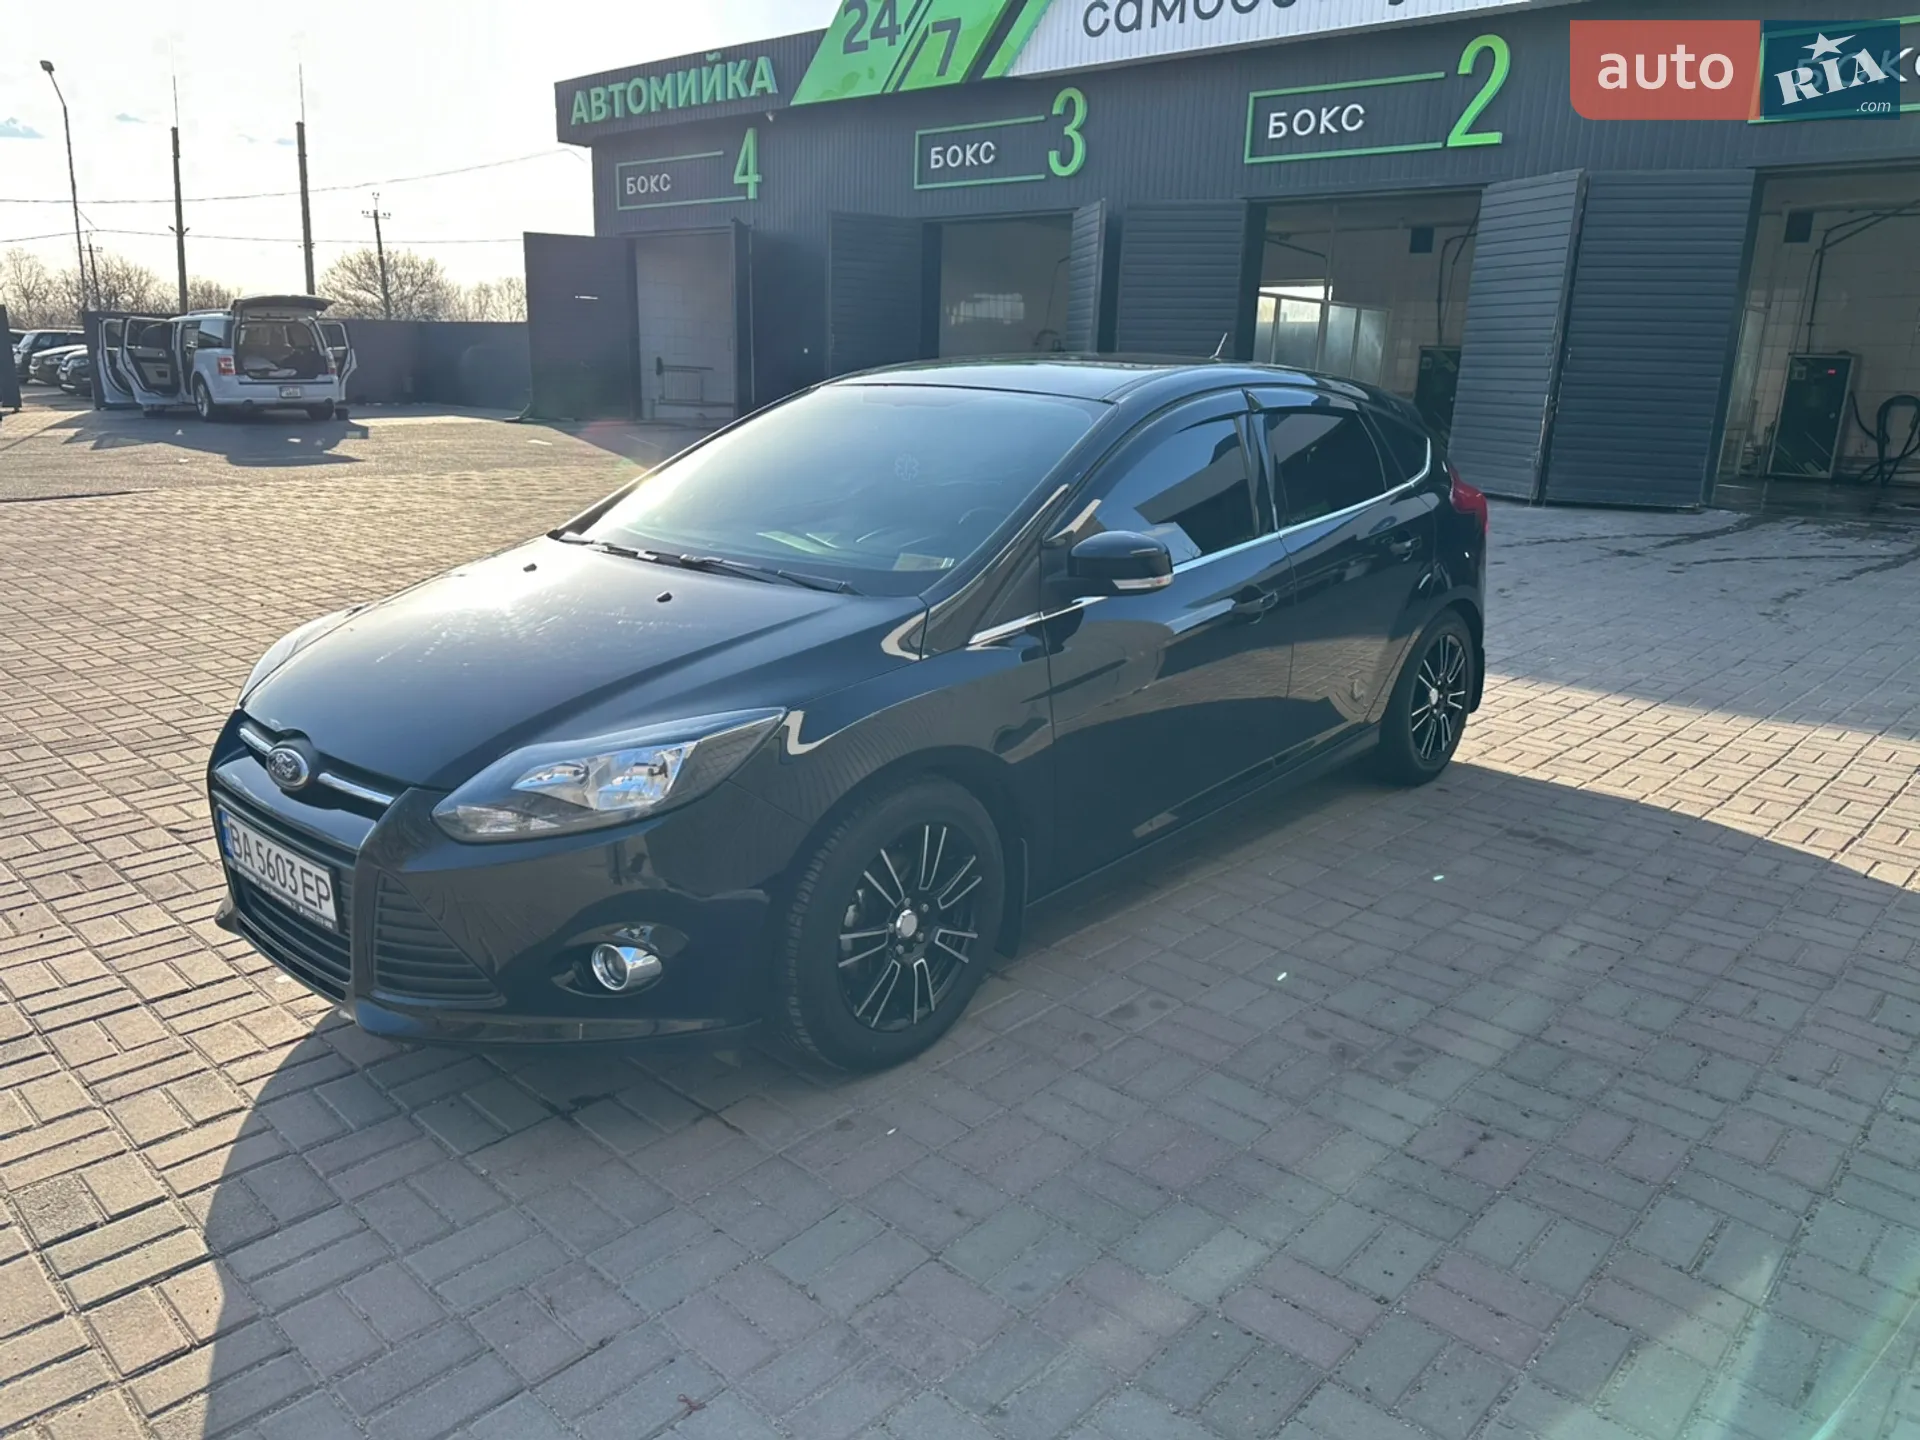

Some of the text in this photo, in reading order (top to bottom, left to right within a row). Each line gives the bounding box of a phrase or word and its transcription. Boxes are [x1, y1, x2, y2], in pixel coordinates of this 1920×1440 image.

[571, 52, 778, 125] АВТОМИЙКА
[1268, 34, 1511, 147] БОКС 2
[1795, 46, 1920, 92] БОК
[626, 128, 762, 200] БОКС 4
[930, 87, 1087, 176] БОКС 3
[229, 823, 255, 868] BA
[255, 840, 298, 895] 5603
[300, 866, 331, 910] EP
